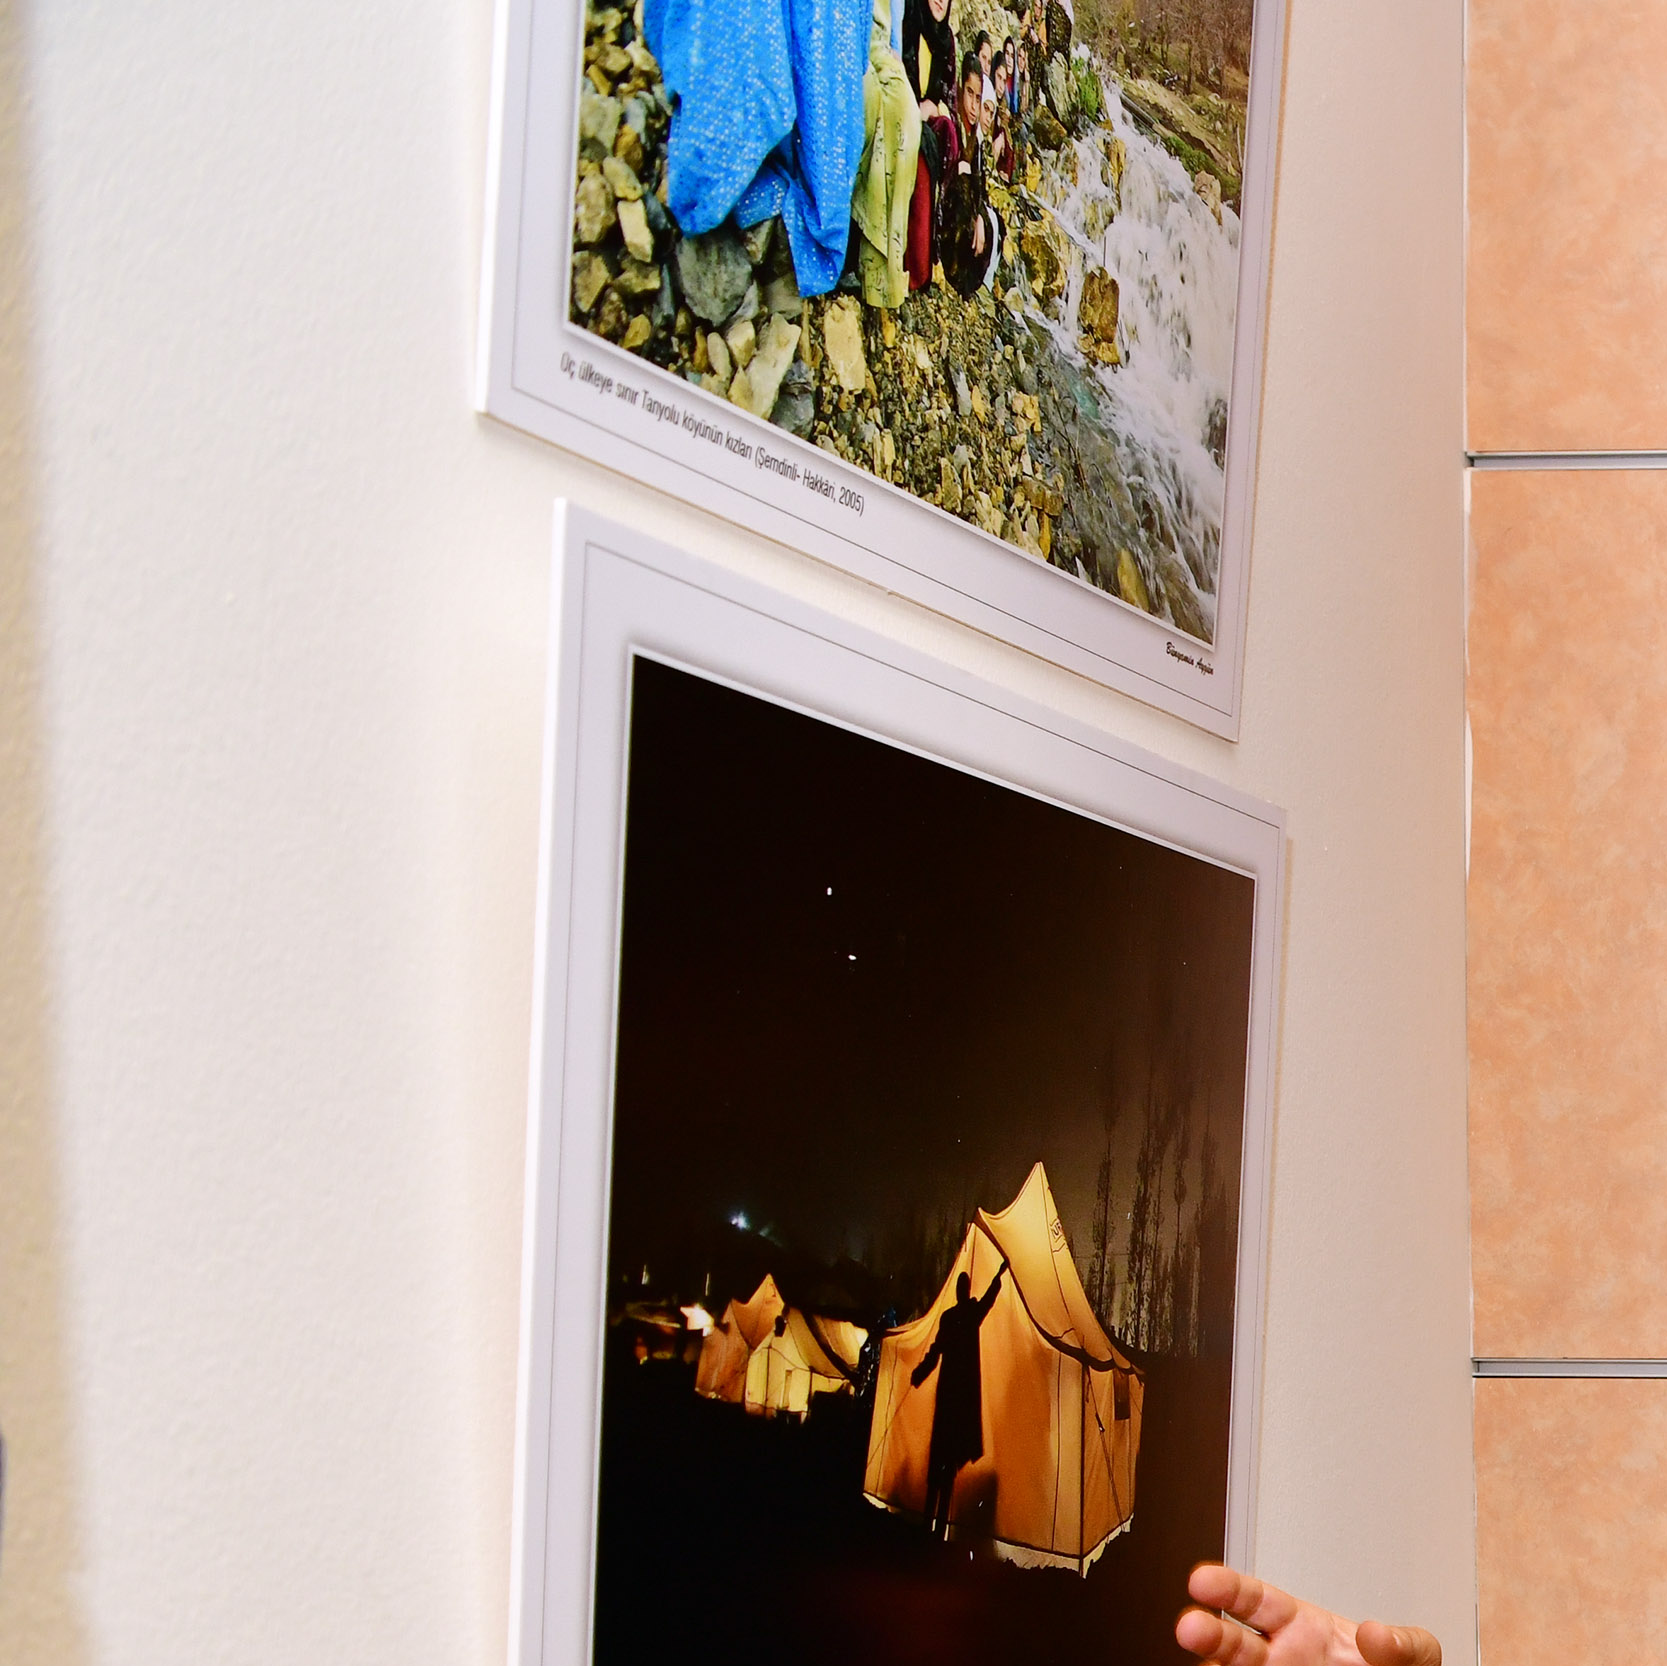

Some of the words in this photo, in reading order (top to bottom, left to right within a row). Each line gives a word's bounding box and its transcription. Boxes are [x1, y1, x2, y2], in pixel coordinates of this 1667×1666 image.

[578, 360, 613, 394] ülkeye
[616, 382, 639, 405] sınır
[641, 389, 680, 421] Tanyolu
[681, 410, 723, 445] köyünün
[724, 431, 753, 460] kızları
[838, 486, 865, 517] 2005)
